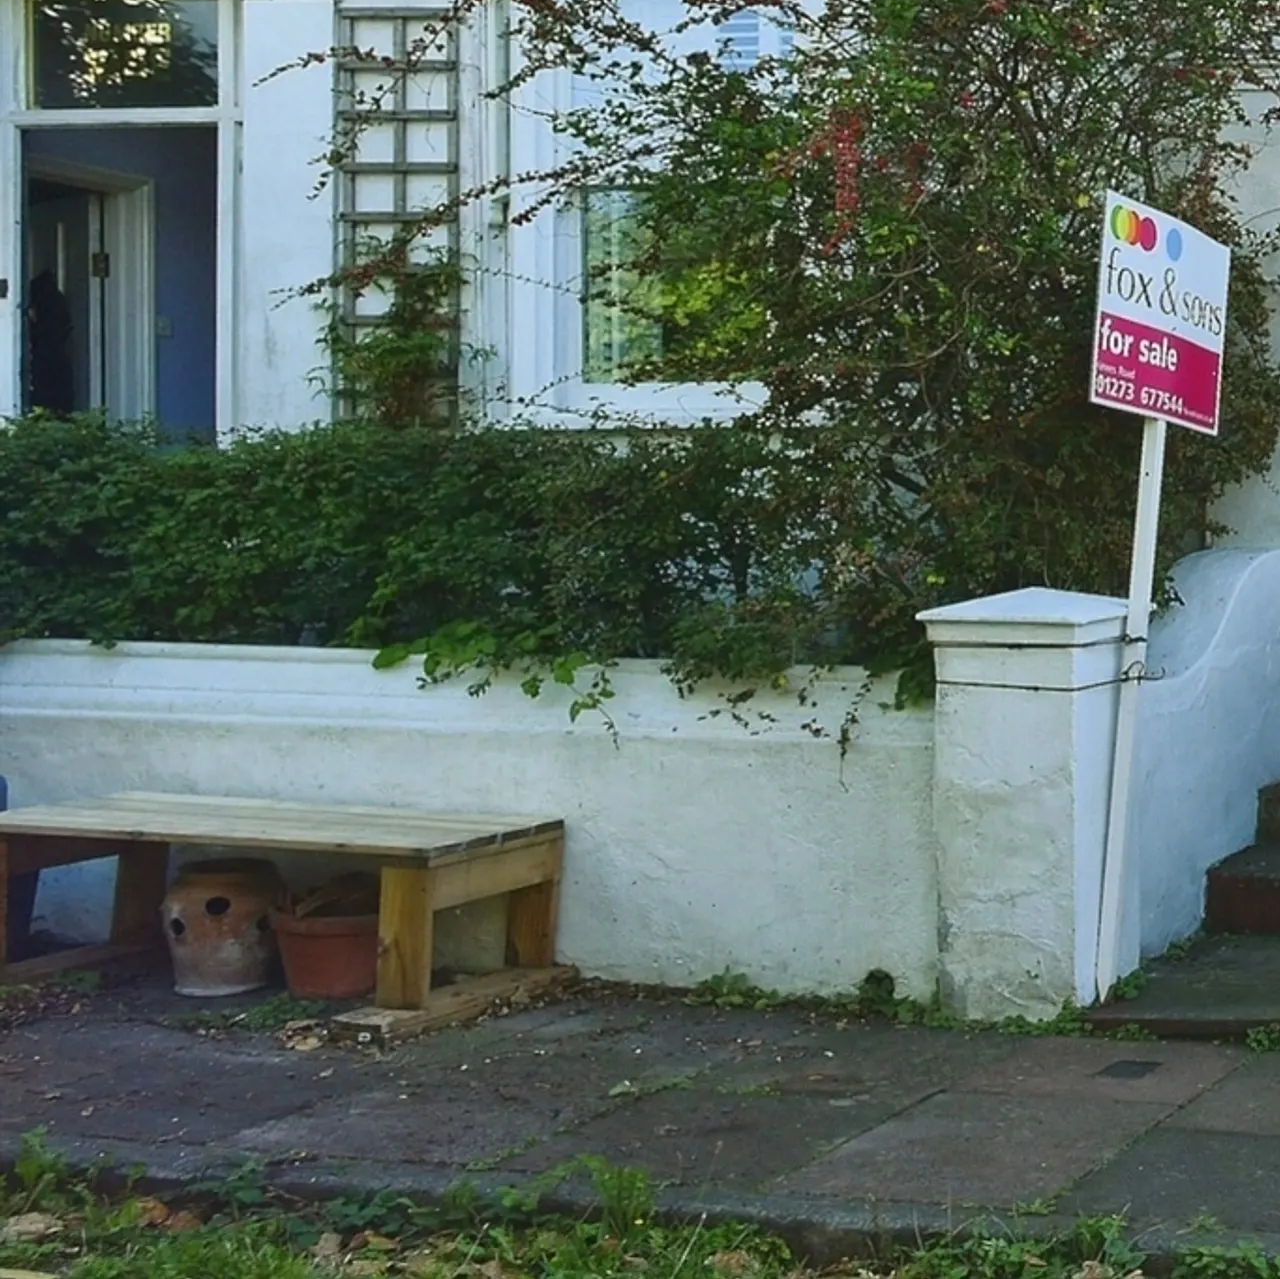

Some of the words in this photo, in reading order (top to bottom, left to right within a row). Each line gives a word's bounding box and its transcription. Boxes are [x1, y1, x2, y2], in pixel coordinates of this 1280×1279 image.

[1107, 246, 1153, 309] fox
[1159, 267, 1177, 317] &
[1181, 291, 1222, 336] sons
[1101, 318, 1134, 358] for
[1138, 336, 1178, 372] sale
[1096, 374, 1135, 401] 01273
[1141, 386, 1184, 414] 677544
